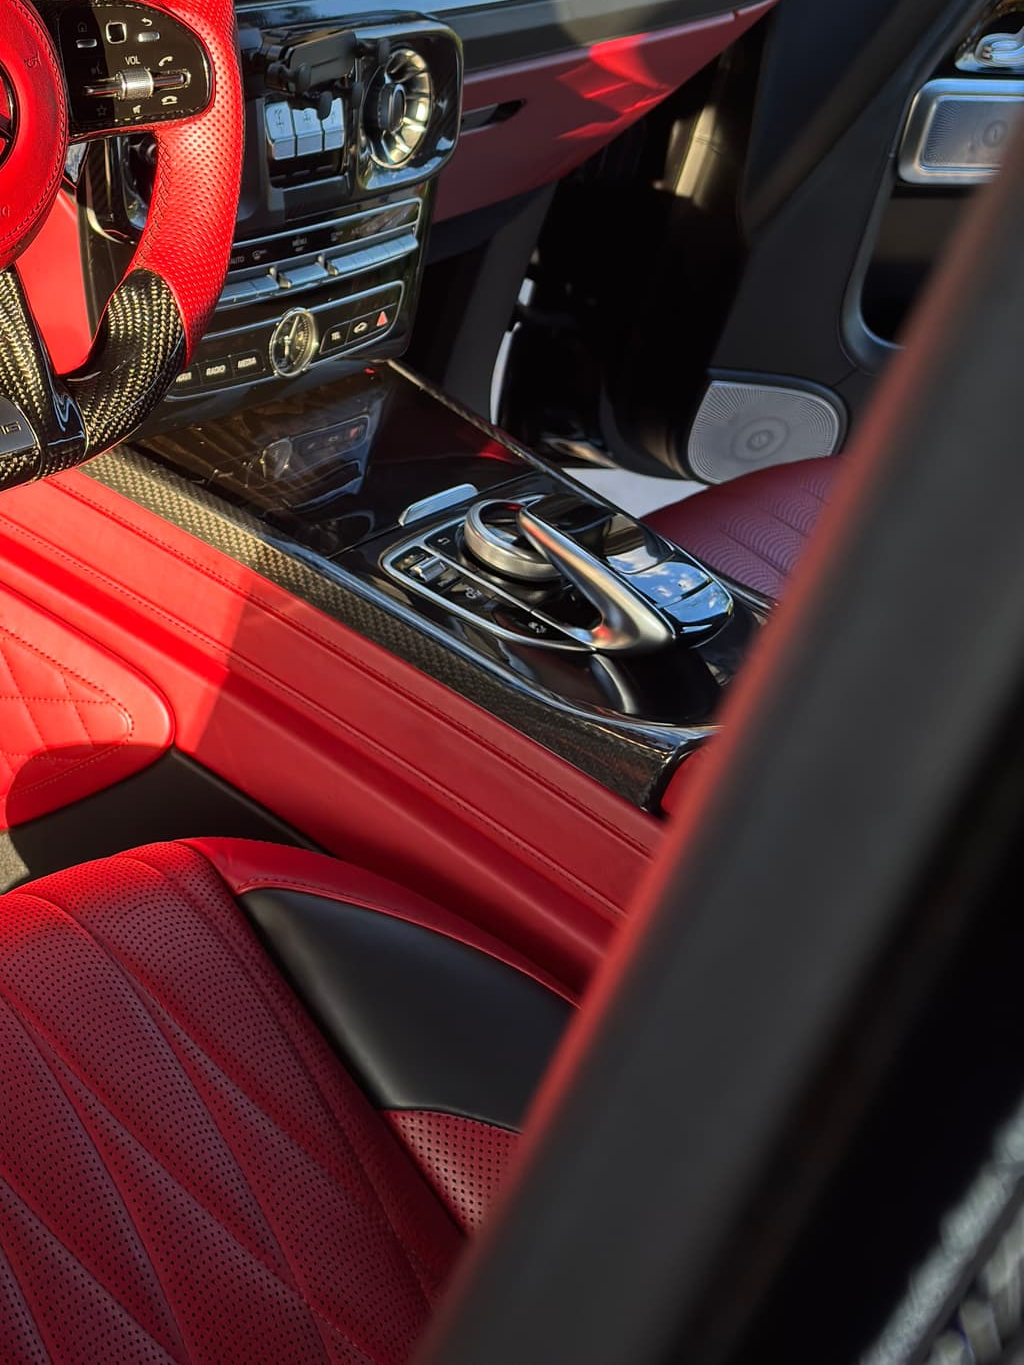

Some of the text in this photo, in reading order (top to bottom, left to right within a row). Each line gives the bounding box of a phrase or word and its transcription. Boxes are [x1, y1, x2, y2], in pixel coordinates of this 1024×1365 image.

[124, 55, 141, 66] VOL
[237, 356, 257, 369] MEDIA
[206, 364, 226, 376] RADIO
